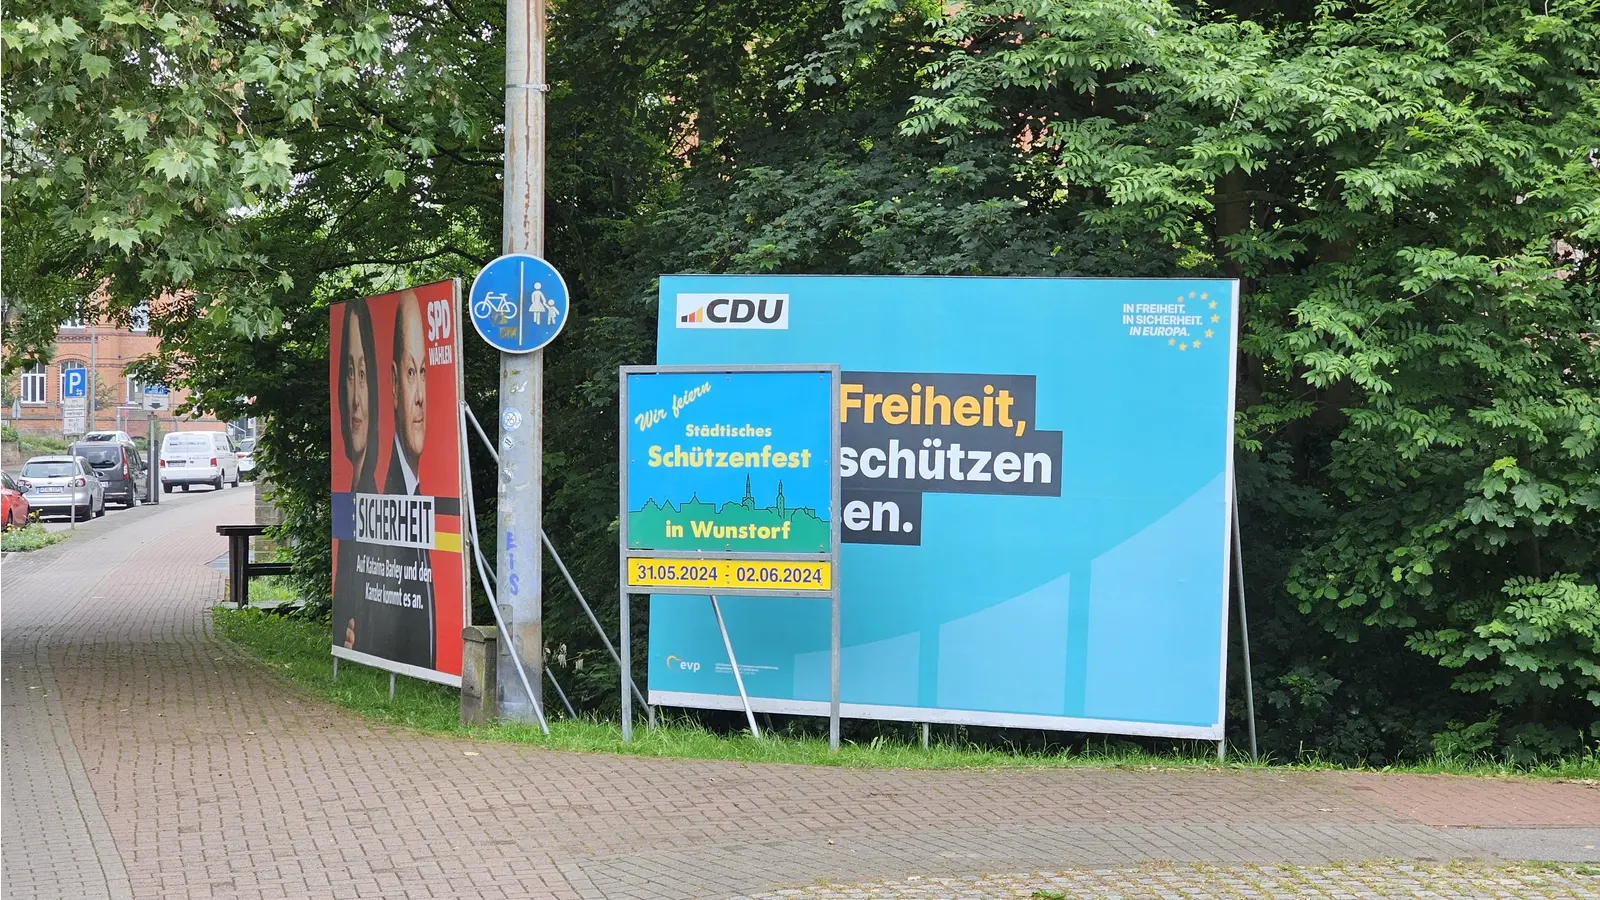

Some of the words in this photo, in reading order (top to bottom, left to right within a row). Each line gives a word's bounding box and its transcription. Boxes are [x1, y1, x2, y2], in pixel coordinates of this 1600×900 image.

[427, 299, 451, 342] SPD
[706, 298, 784, 324] CDU
[1122, 314, 1134, 325] IN
[1135, 315, 1203, 325] SICHERHEIT.
[1123, 303, 1134, 313] IN
[1136, 303, 1186, 314] FREIHEIT.
[1129, 326, 1141, 336] IN
[1142, 326, 1191, 337] EUROPA.
[428, 342, 453, 366] WÄHLEN
[69, 372, 82, 394] P
[634, 408, 667, 432] Wir
[671, 381, 712, 418] feiern
[839, 382, 1027, 437] Freiheit,
[685, 423, 772, 437] Städtisches
[648, 444, 812, 468] Schützenfest
[839, 437, 1053, 484] schützen
[358, 497, 432, 544] SICHERHEIT
[840, 499, 914, 533] en.
[665, 519, 684, 538] in
[690, 520, 791, 539] Wunstorf
[356, 554, 366, 573] Auf
[366, 556, 385, 577] Katarina
[385, 559, 403, 585] Barley
[404, 561, 417, 581] und
[419, 561, 432, 583] den
[637, 564, 718, 581] 31.05.2024
[736, 566, 822, 584] 02.06.2024
[365, 582, 383, 603] Kanzler
[383, 584, 403, 607] kommt
[403, 592, 411, 608] es
[412, 593, 424, 610] an.
[680, 660, 701, 673] evp
